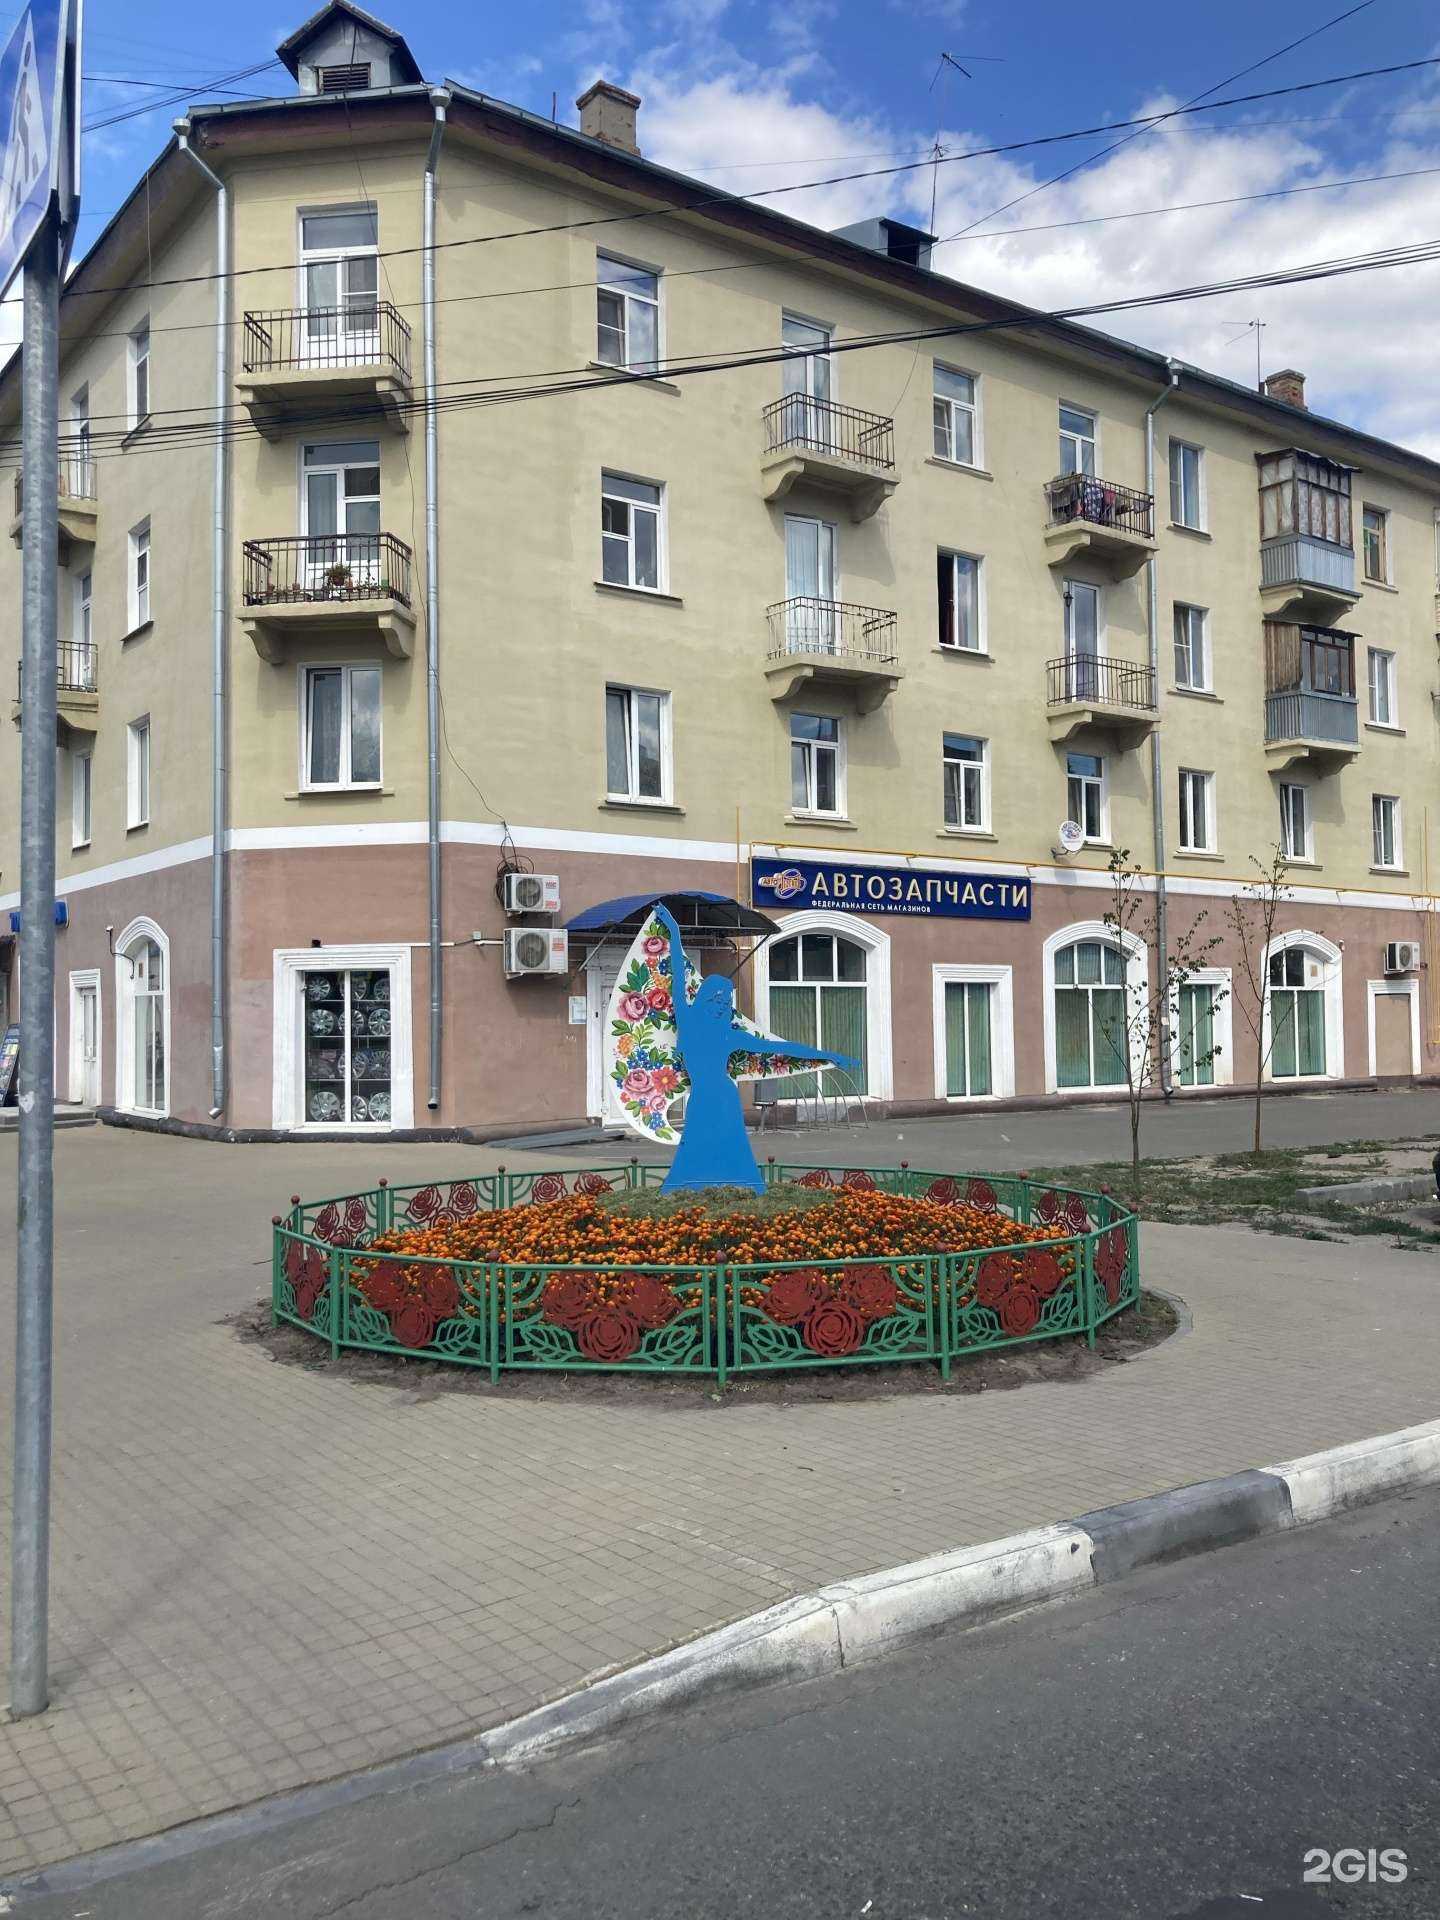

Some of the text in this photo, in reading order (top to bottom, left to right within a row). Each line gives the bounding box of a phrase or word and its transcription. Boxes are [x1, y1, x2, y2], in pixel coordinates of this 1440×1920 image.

[811, 872, 1028, 908] АВТОЗАПЧАСТИ
[811, 900, 931, 913] ФЕДЕРАЛЬНАЯ СЕТЬ МАГАЗИНОВ
